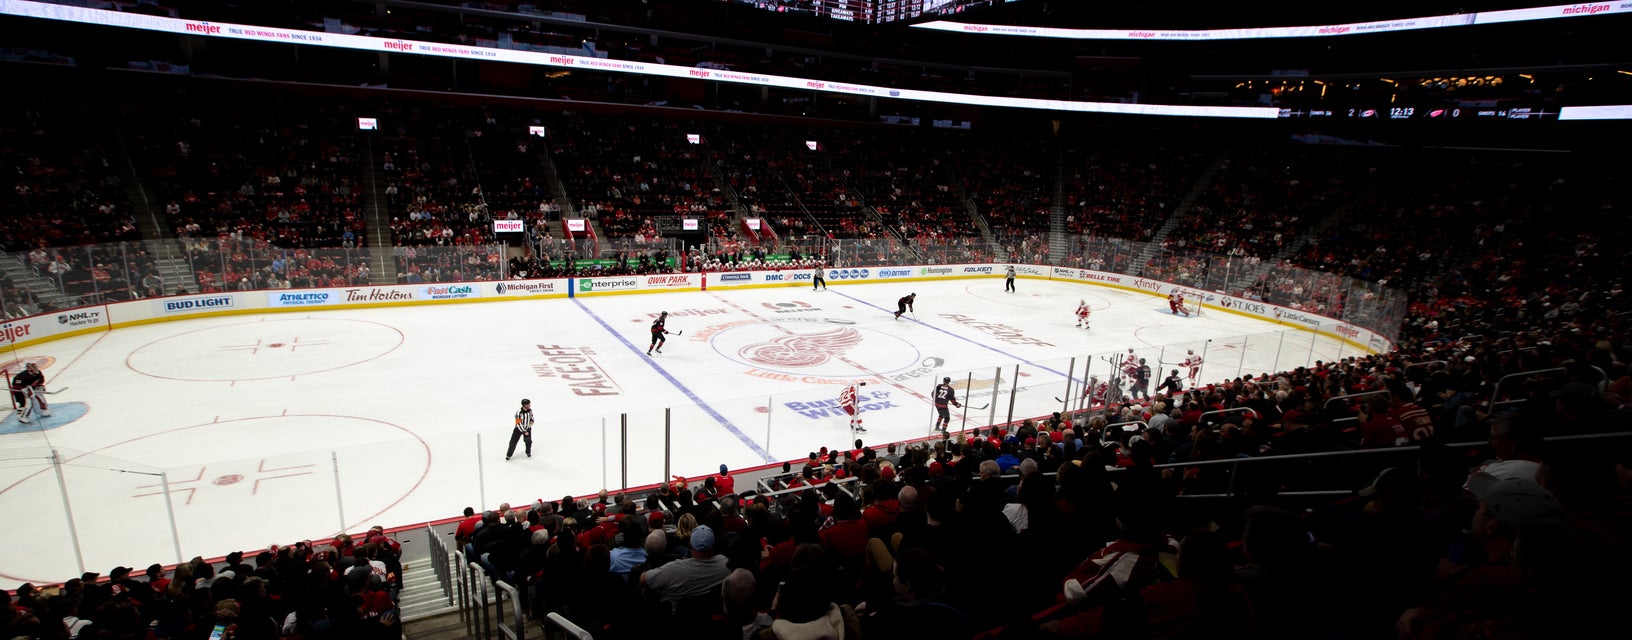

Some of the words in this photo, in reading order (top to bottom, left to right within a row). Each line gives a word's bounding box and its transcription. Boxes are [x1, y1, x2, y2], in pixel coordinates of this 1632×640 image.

[1562, 3, 1610, 15] michigan
[185, 21, 221, 35] meijer
[228, 27, 243, 35] TRUE
[257, 30, 275, 38] WINGS
[291, 33, 307, 41] SINCE
[1318, 25, 1351, 35] michigan
[383, 39, 413, 52] meijer
[550, 55, 575, 66] meijer
[689, 67, 710, 79] meijer
[1347, 108, 1354, 117] 2
[1390, 107, 1415, 116] 12:13
[1452, 108, 1460, 117] 0
[496, 220, 522, 233] meijer
[568, 223, 584, 231] meijer
[684, 222, 698, 231] meijer
[793, 273, 811, 281] DOCS
[927, 267, 953, 275] Huntington
[647, 276, 668, 285] QWIK
[668, 275, 689, 284] PARK
[1106, 275, 1121, 283] TIRE
[1133, 278, 1162, 292] xfinity
[427, 285, 473, 295] FastCash
[507, 284, 538, 292] Michigan
[538, 282, 554, 290] First
[279, 293, 329, 302] ATHLETICO
[345, 288, 367, 302] Tim
[369, 288, 412, 301] Hortons
[166, 301, 194, 311] BUD
[195, 297, 231, 307] LIGHT
[1244, 302, 1266, 315] JOE'S
[1283, 311, 1299, 321] Little
[1299, 315, 1320, 327] Caesars
[530, 362, 557, 377] NHL
[537, 344, 620, 397] FACE-OFF
[744, 368, 798, 382] Little
[889, 367, 932, 382] arena
[938, 390, 949, 399] 22
[784, 394, 872, 412] Burs
